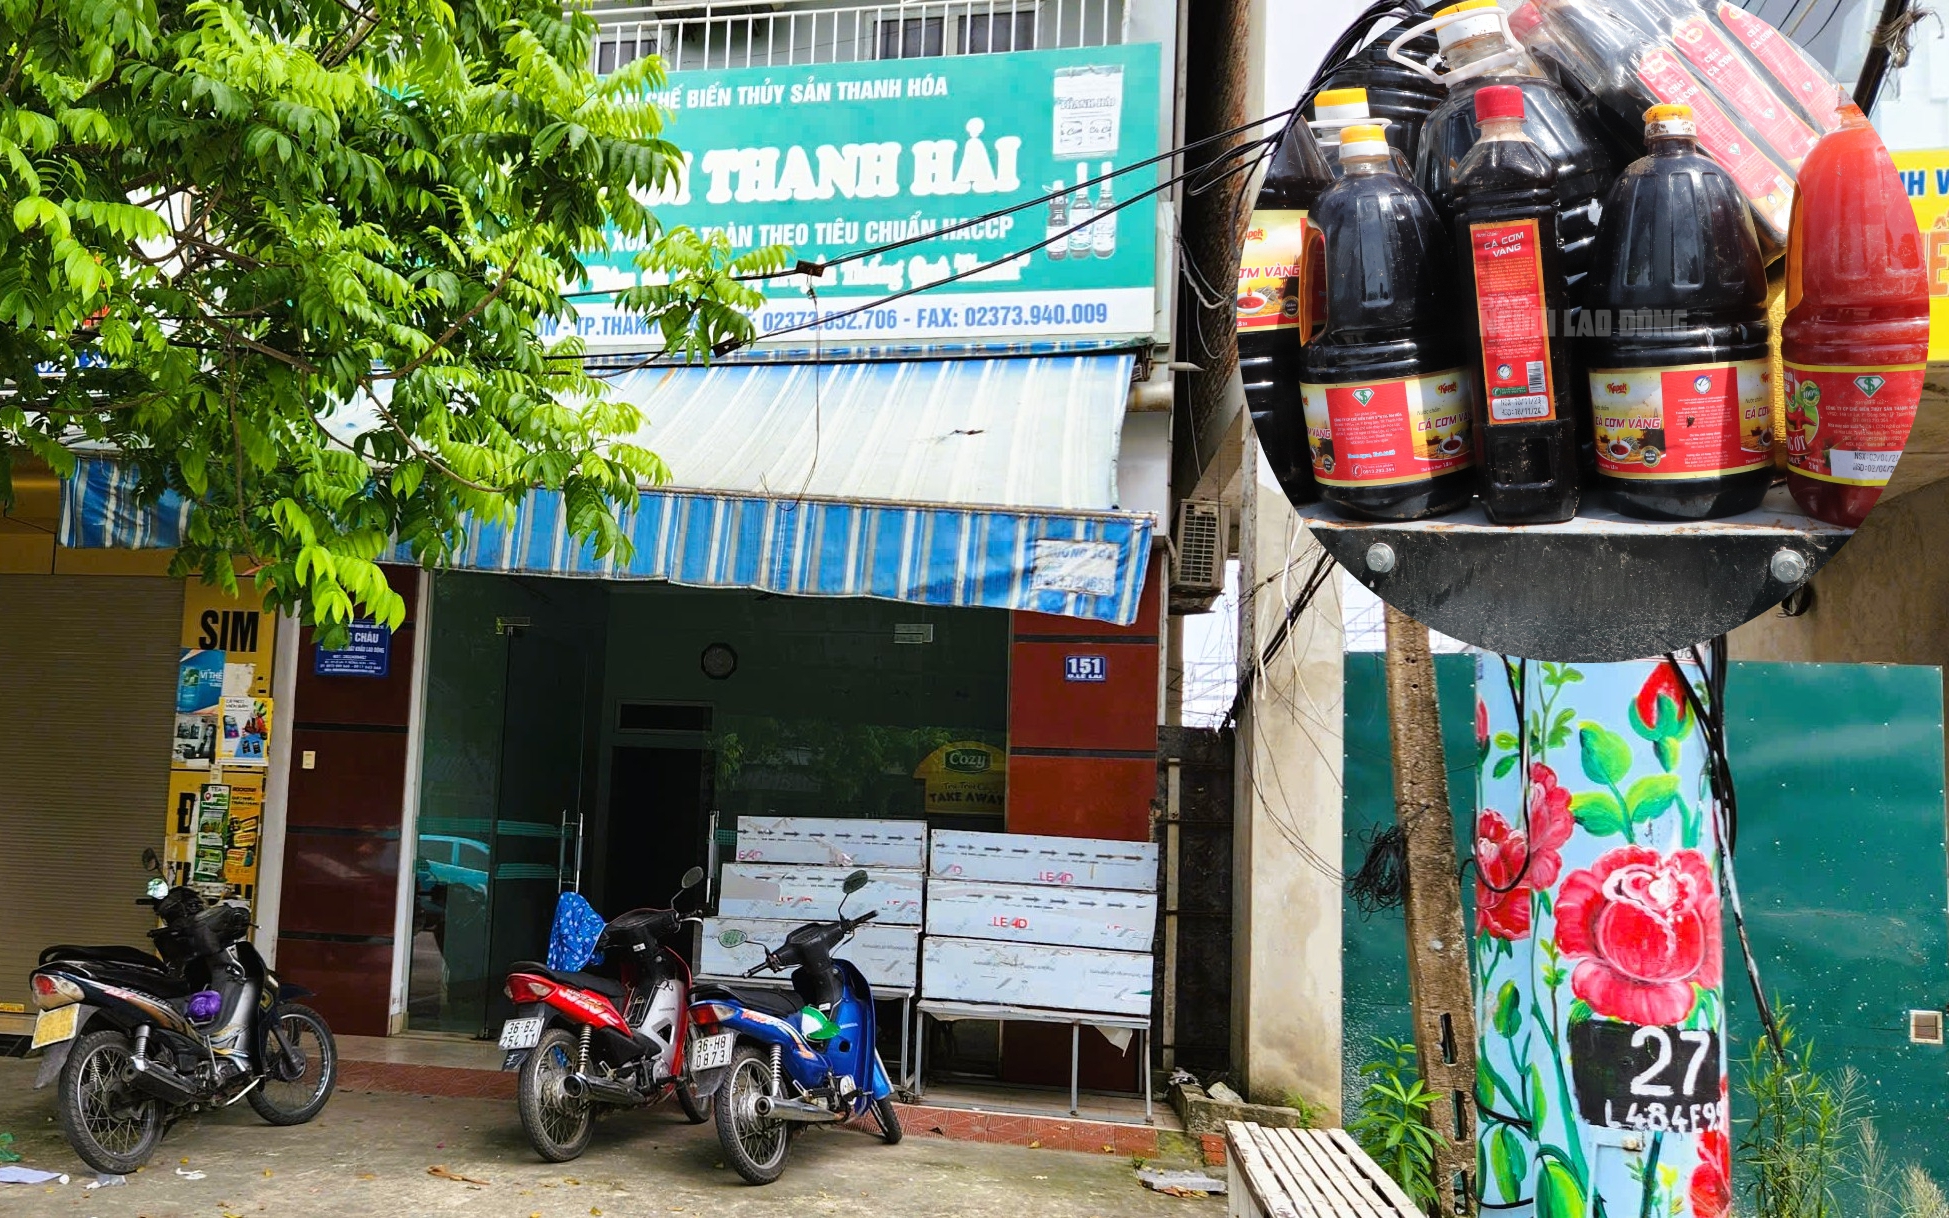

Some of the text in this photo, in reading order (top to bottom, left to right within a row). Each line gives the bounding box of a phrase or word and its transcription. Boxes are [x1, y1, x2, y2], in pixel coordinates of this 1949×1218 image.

[687, 81, 731, 108] BIẾN
[738, 78, 785, 105] THỦY
[790, 76, 831, 102] SẢN
[837, 77, 901, 100] THANH
[907, 73, 948, 97] HÓA
[702, 142, 902, 204] THANH
[910, 117, 1022, 196] HẢI
[758, 223, 809, 247] THEO
[816, 217, 859, 245] TIÊU
[865, 210, 936, 243] CHUẨN
[949, 215, 1015, 241] HACCP
[1484, 239, 1498, 250] CÁ
[1492, 243, 1522, 257] VÀNG
[1238, 263, 1301, 279] ƠM VÀNG
[917, 307, 958, 328] FAX:
[965, 303, 1107, 327] 02373.940.009
[1744, 405, 1756, 420] CÁ
[1417, 420, 1432, 432] CÁ
[1435, 415, 1457, 428] CƠM
[1595, 415, 1661, 429] CÁ CƠM VÀNG
[198, 609, 259, 652] SIM
[1068, 658, 1101, 674] 151
[949, 751, 986, 769] Cozy
[930, 791, 962, 803] TAKE
[696, 1049, 726, 1068] 0873
[1630, 1025, 1710, 1096] 27
